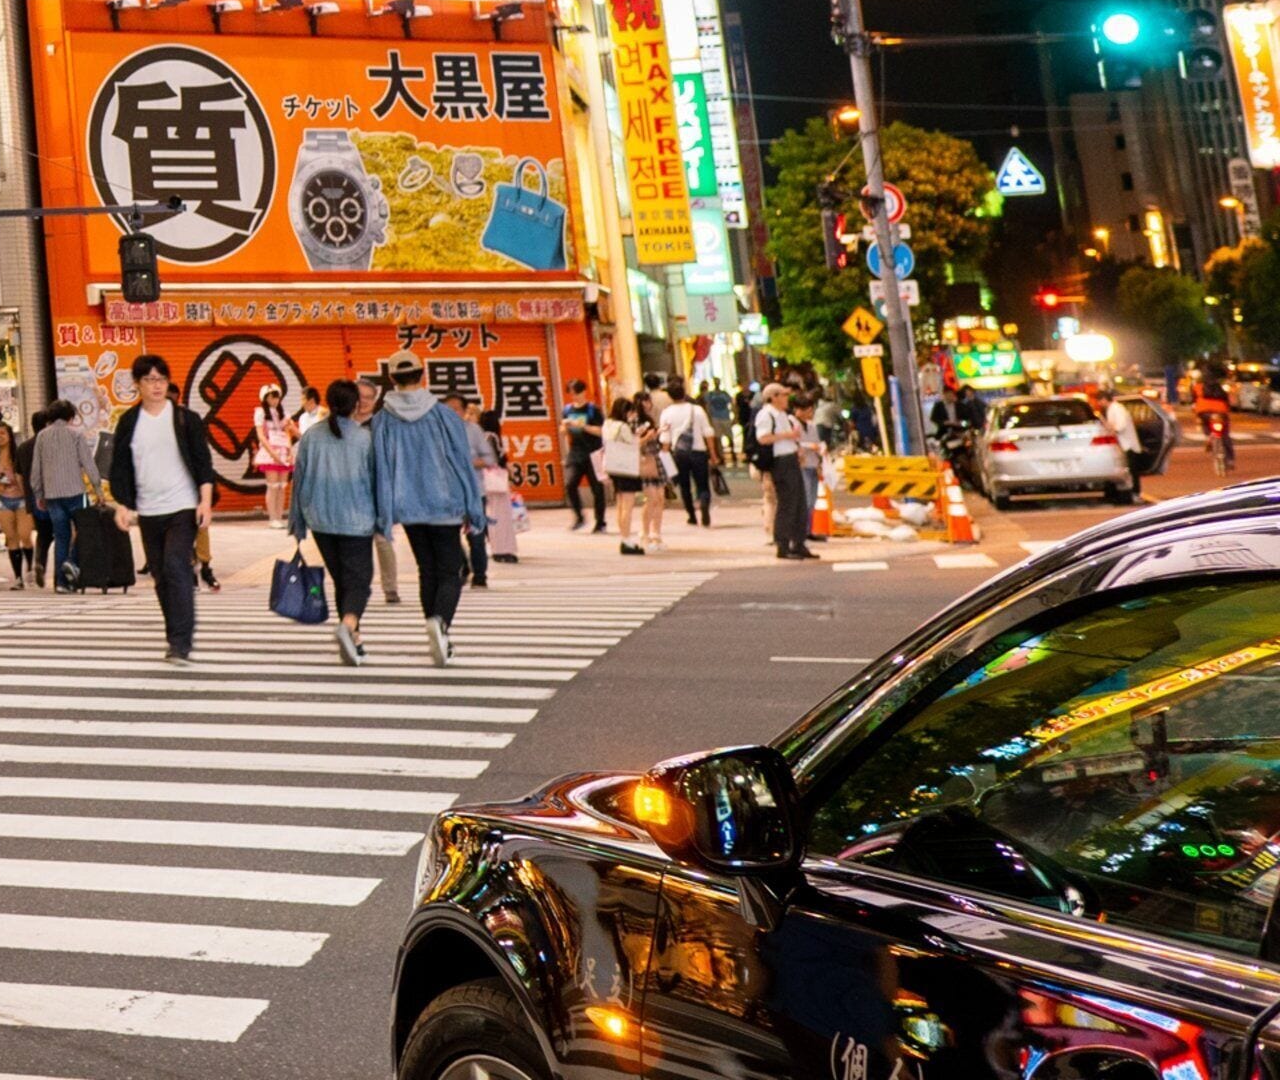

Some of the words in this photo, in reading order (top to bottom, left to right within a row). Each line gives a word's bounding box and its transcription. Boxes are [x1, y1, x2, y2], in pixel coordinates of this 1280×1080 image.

[366, 51, 553, 122] 大黒屋
[641, 40, 669, 105] TAX
[282, 93, 361, 121] チケット
[110, 76, 262, 233] 質
[653, 117, 684, 201] FREE
[638, 224, 691, 237] AKIHABARA
[642, 240, 692, 253] TOKIS
[107, 300, 180, 322] 高価買取
[57, 322, 80, 348] 質
[82, 325, 96, 344] &
[98, 322, 139, 347] 買取
[396, 324, 501, 352] チケット
